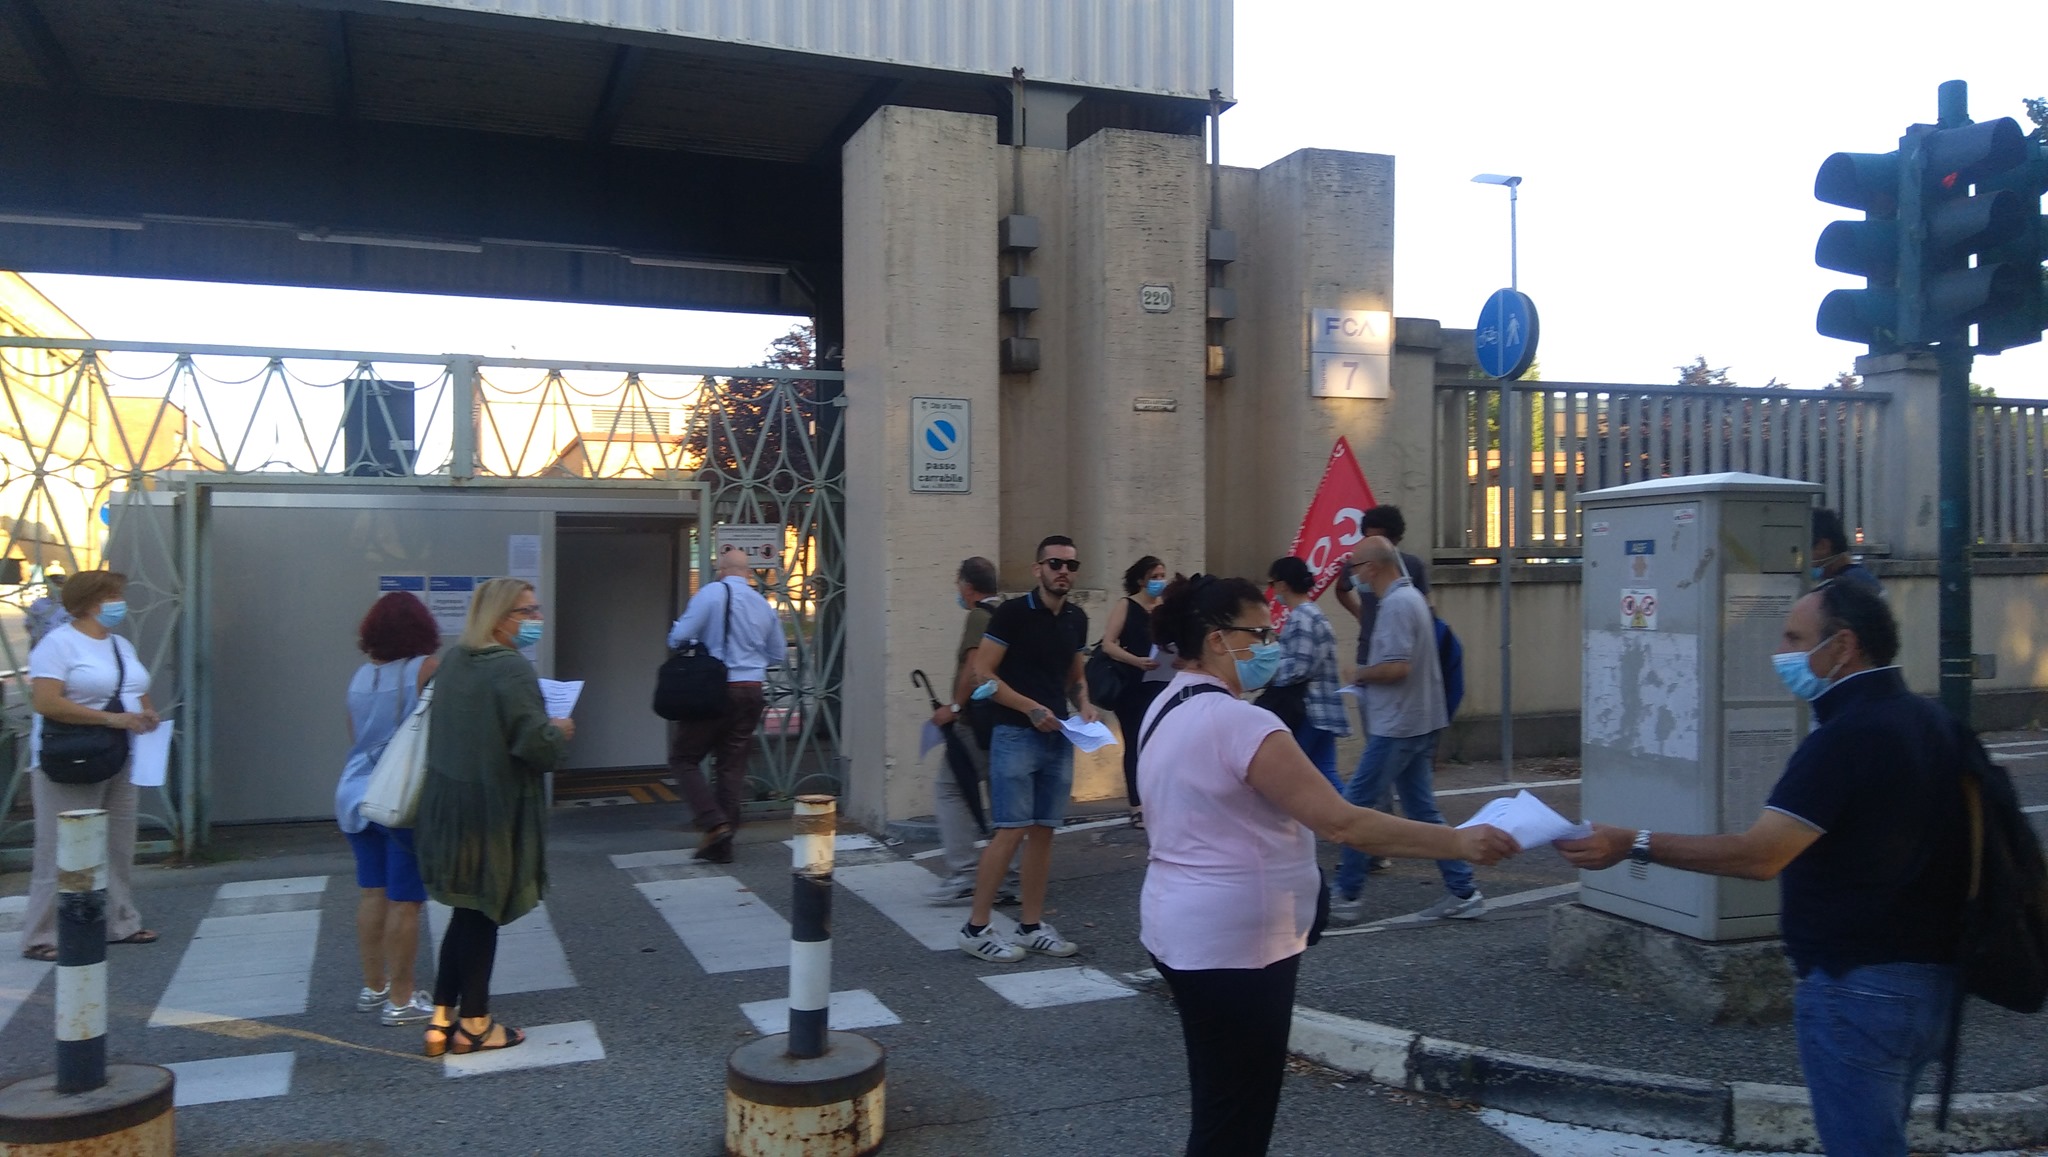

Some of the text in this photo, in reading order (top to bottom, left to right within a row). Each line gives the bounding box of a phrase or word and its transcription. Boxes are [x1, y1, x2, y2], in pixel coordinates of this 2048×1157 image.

[1144, 290, 1170, 306] 220
[1325, 317, 1376, 337] FCA
[1342, 361, 1360, 391] 7
[925, 462, 957, 471] passo
[918, 474, 964, 483] carrabile
